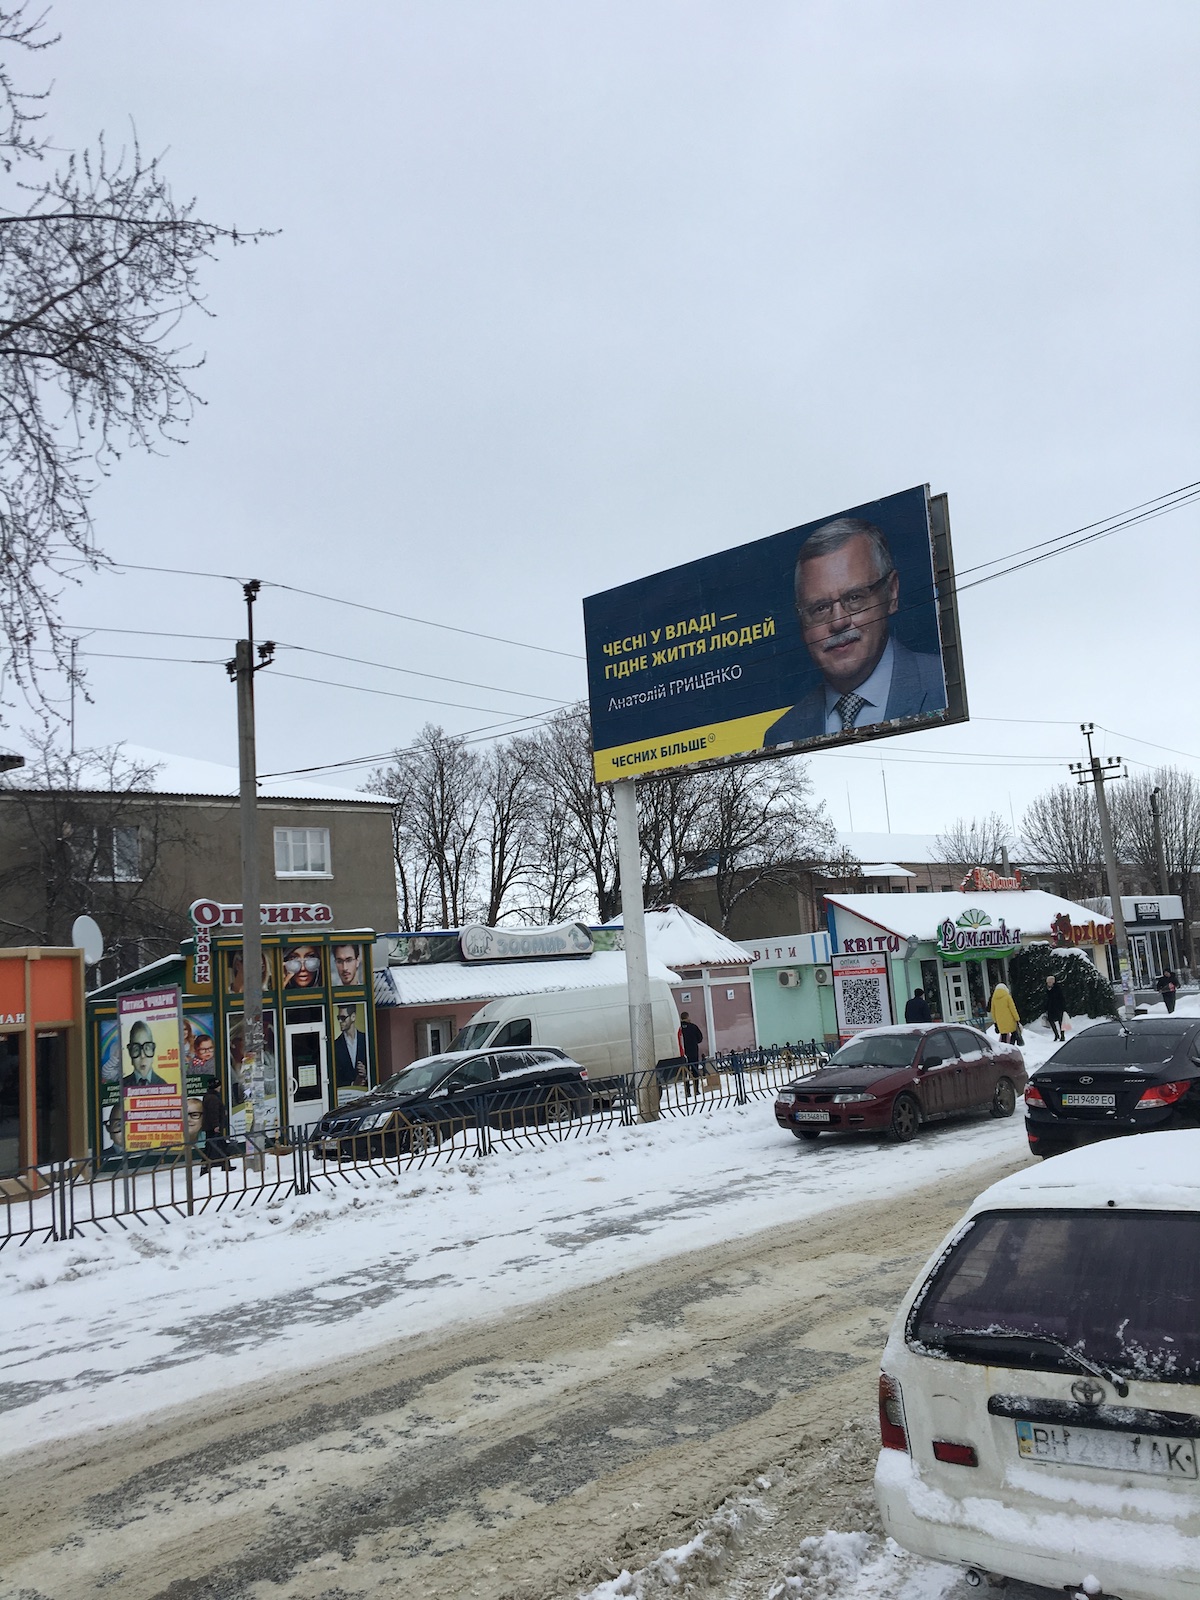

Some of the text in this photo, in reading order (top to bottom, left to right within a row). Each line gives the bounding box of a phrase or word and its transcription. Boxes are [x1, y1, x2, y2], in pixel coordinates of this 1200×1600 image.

[603, 633, 647, 657] ЧЕСНІ
[650, 629, 662, 644] У
[665, 613, 716, 641] ВЛАДІ
[605, 616, 776, 679] ГІДНЕ ЖИТТЯ ЛЮДЕЙ
[608, 664, 743, 712] Анатолій ГРИЦЕНКО
[612, 748, 657, 768] ЧЕСНИХ
[660, 737, 707, 758] БІЛЬШЕ
[1067, 1095, 1114, 1105] BH 9489 EO
